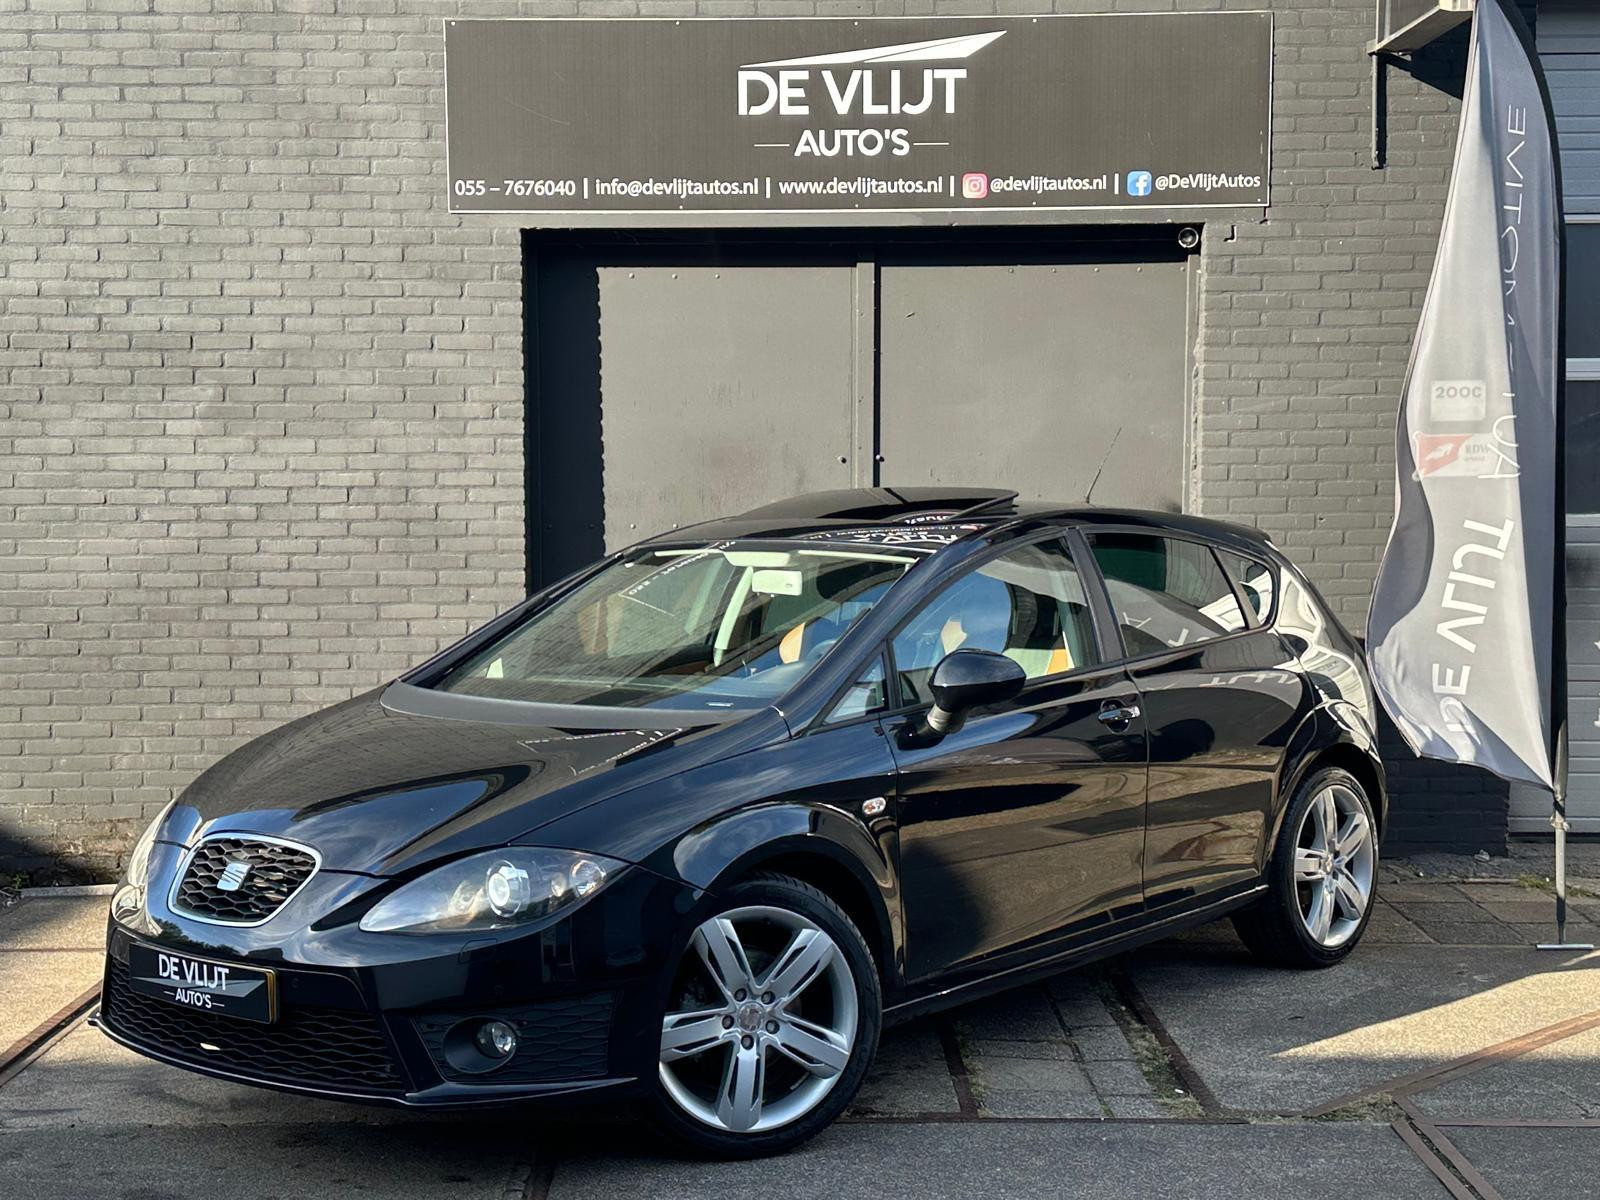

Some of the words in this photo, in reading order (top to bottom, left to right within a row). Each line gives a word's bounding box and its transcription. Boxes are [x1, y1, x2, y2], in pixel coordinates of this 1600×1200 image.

[737, 70, 810, 116] DE
[821, 68, 968, 116] VLIJT
[794, 128, 911, 157] AUTO'S
[454, 179, 486, 197] 055
[503, 179, 576, 197] 7676040
[595, 177, 759, 199] info@devlijtautos.nl
[778, 175, 943, 198] www.devlijtautos.nl
[990, 174, 1107, 195] @devlijtautos.nl
[1154, 172, 1261, 193] @DeVlijtAutos
[158, 953, 180, 981] DE
[181, 958, 230, 991] VLIJT
[175, 987, 213, 1009] AUTO'S
